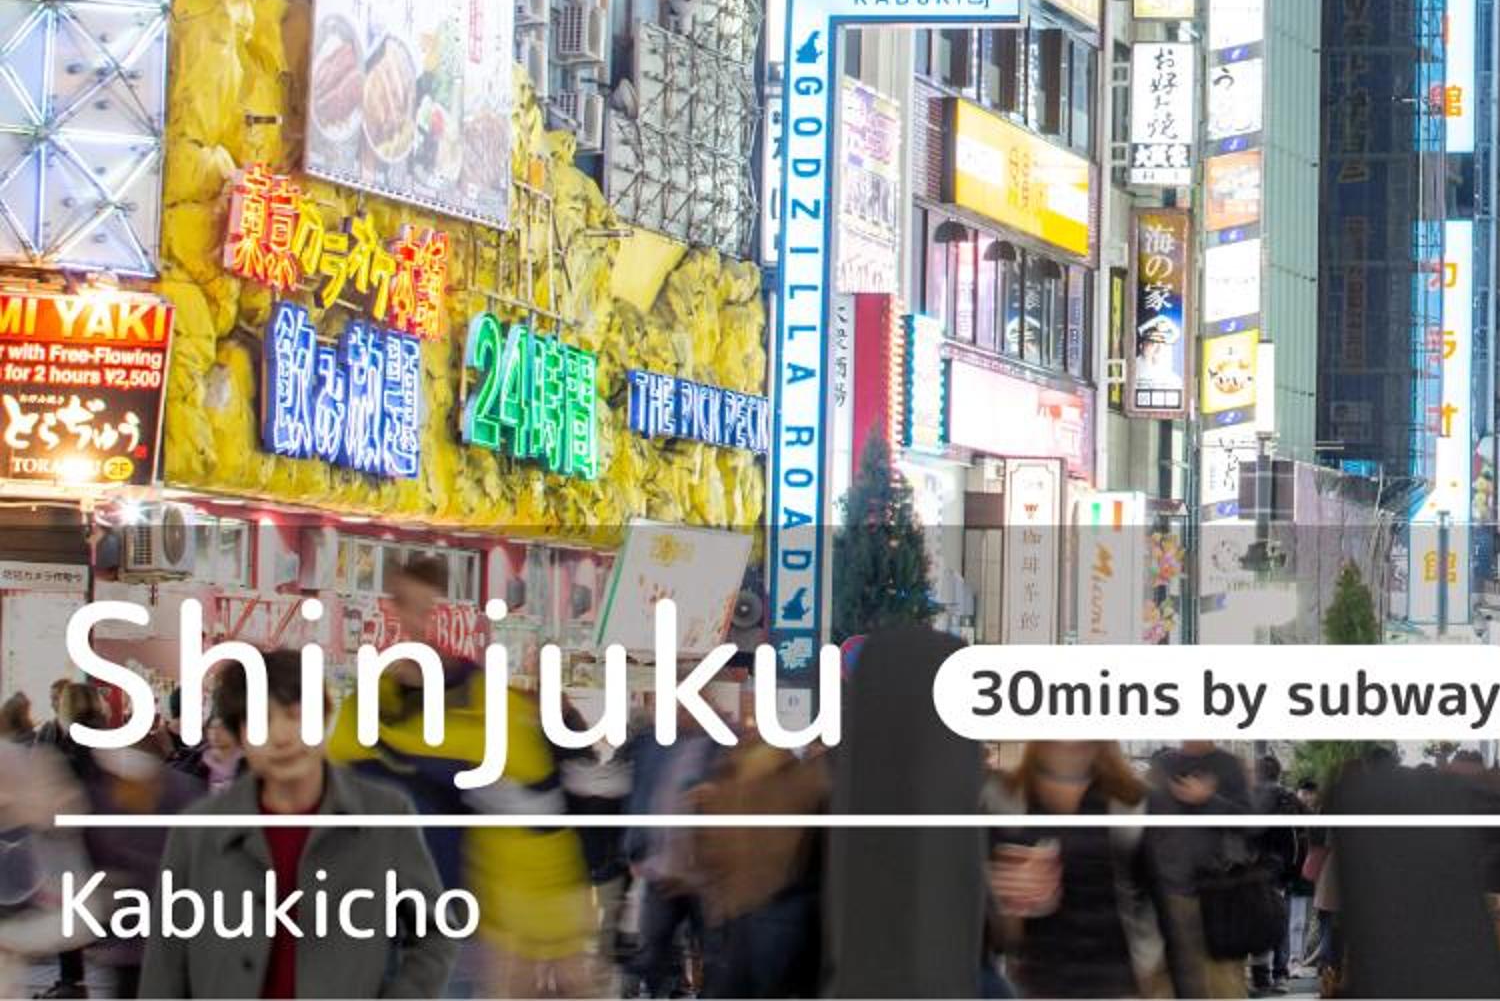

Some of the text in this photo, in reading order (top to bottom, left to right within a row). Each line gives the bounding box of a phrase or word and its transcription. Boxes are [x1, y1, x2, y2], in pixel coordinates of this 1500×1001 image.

[1144, 223, 1174, 311] 海の家
[8, 343, 162, 369] with Free-Flowing
[56, 299, 167, 342] YAKI
[780, 76, 824, 572] GODZILLA ROAD
[4, 365, 161, 388] for 2 hours ¥2,500
[273, 303, 419, 477] 飲み放題
[472, 312, 599, 480] 24時間
[634, 370, 677, 436] THE
